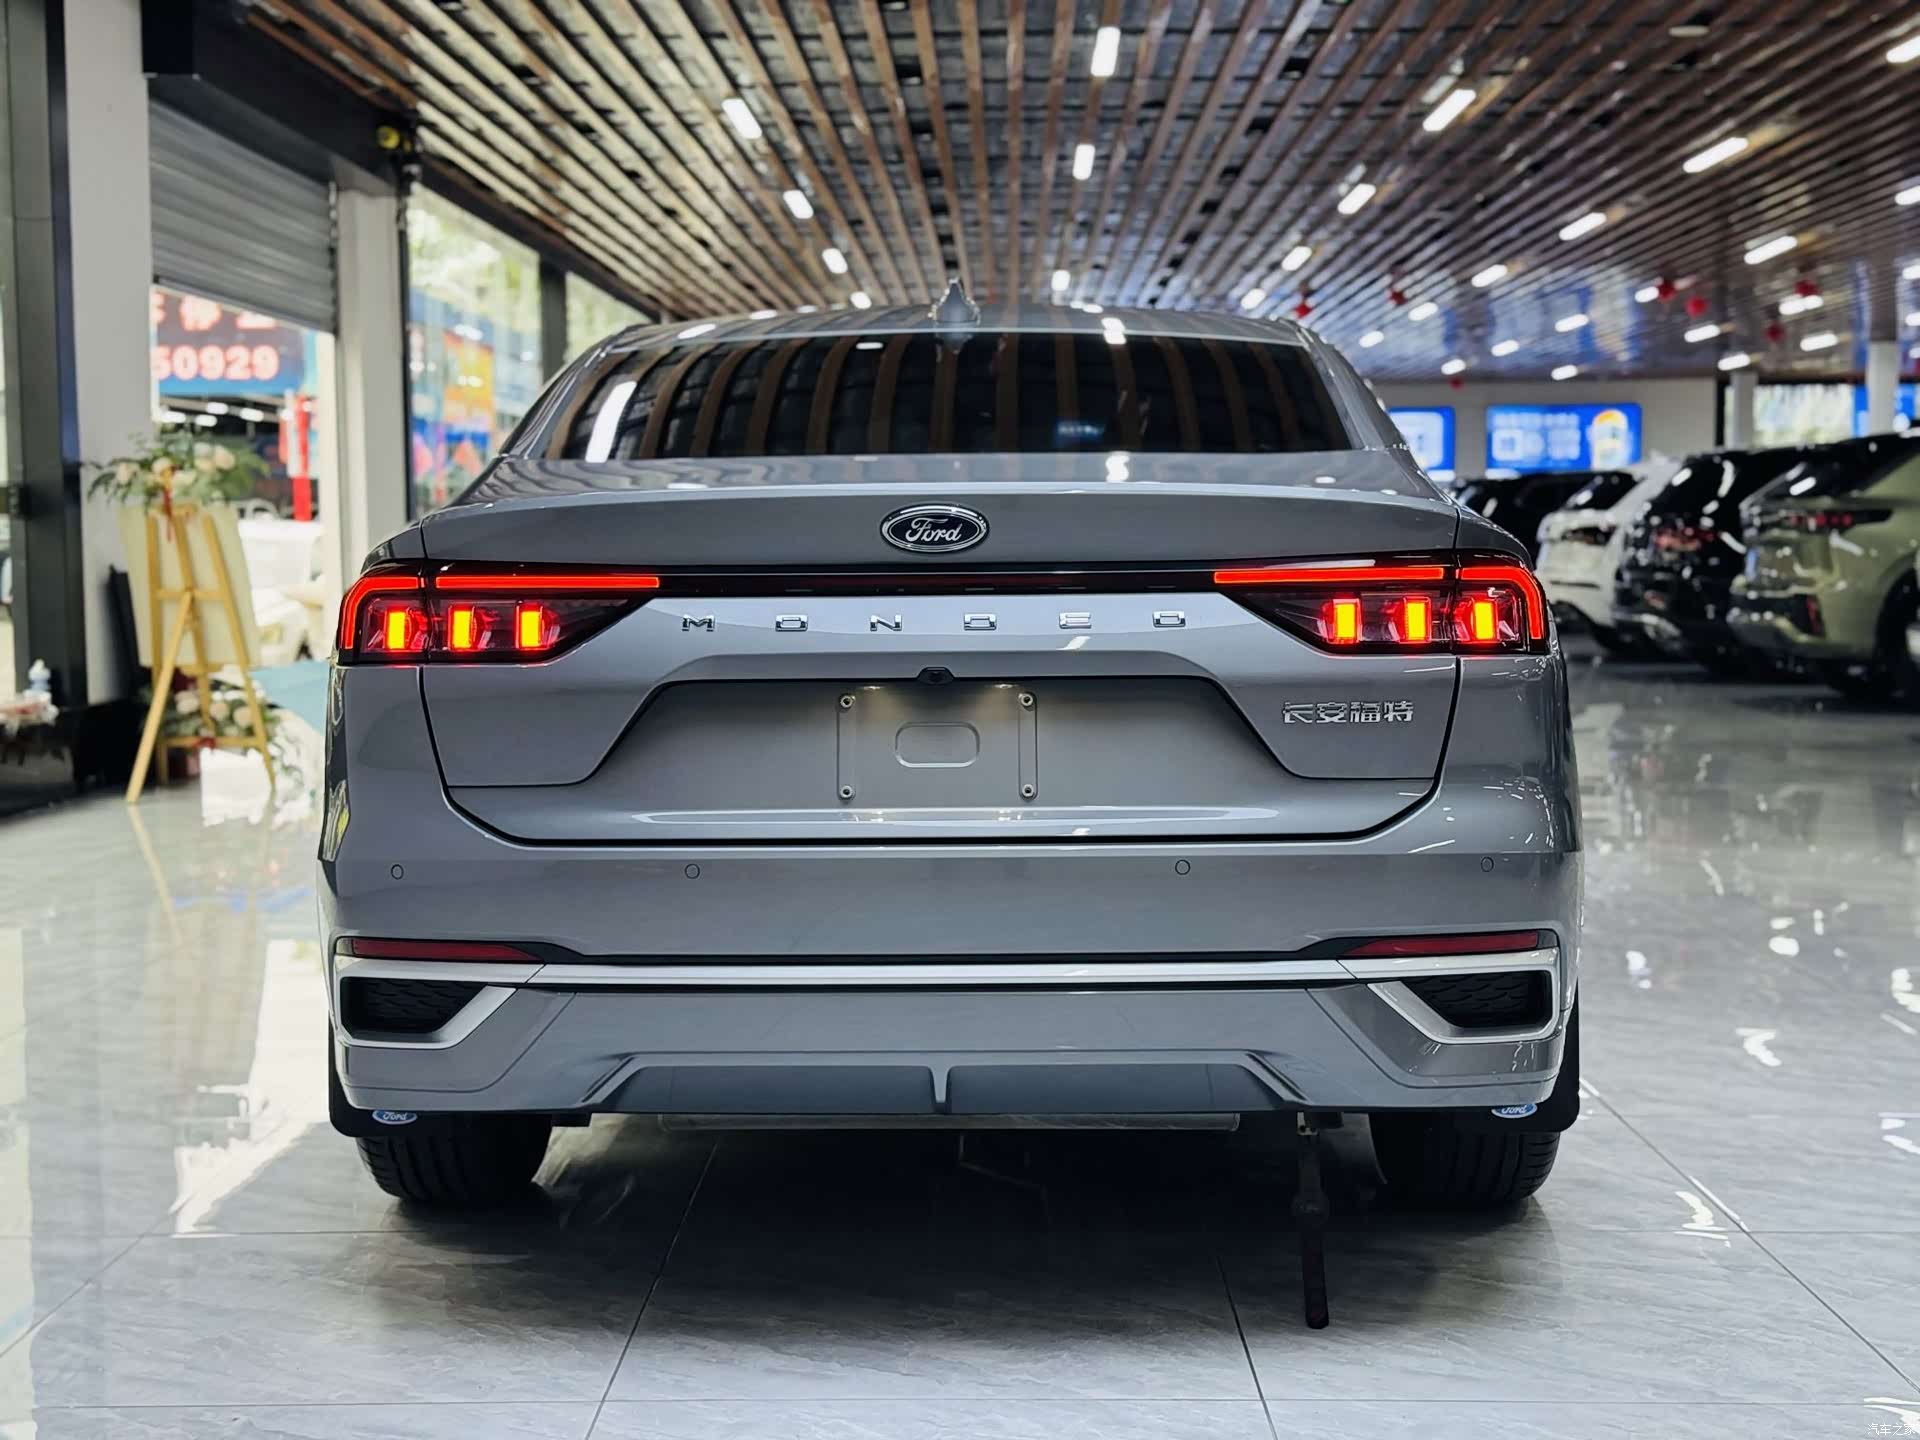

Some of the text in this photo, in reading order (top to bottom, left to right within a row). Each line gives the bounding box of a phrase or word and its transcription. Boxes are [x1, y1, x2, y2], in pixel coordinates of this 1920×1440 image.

[905, 517, 963, 542] Ford
[682, 610, 1186, 632] MONDEO
[1283, 701, 1413, 723] 长安福特
[383, 1111, 408, 1120] Ford
[1501, 1104, 1527, 1114] Ford
